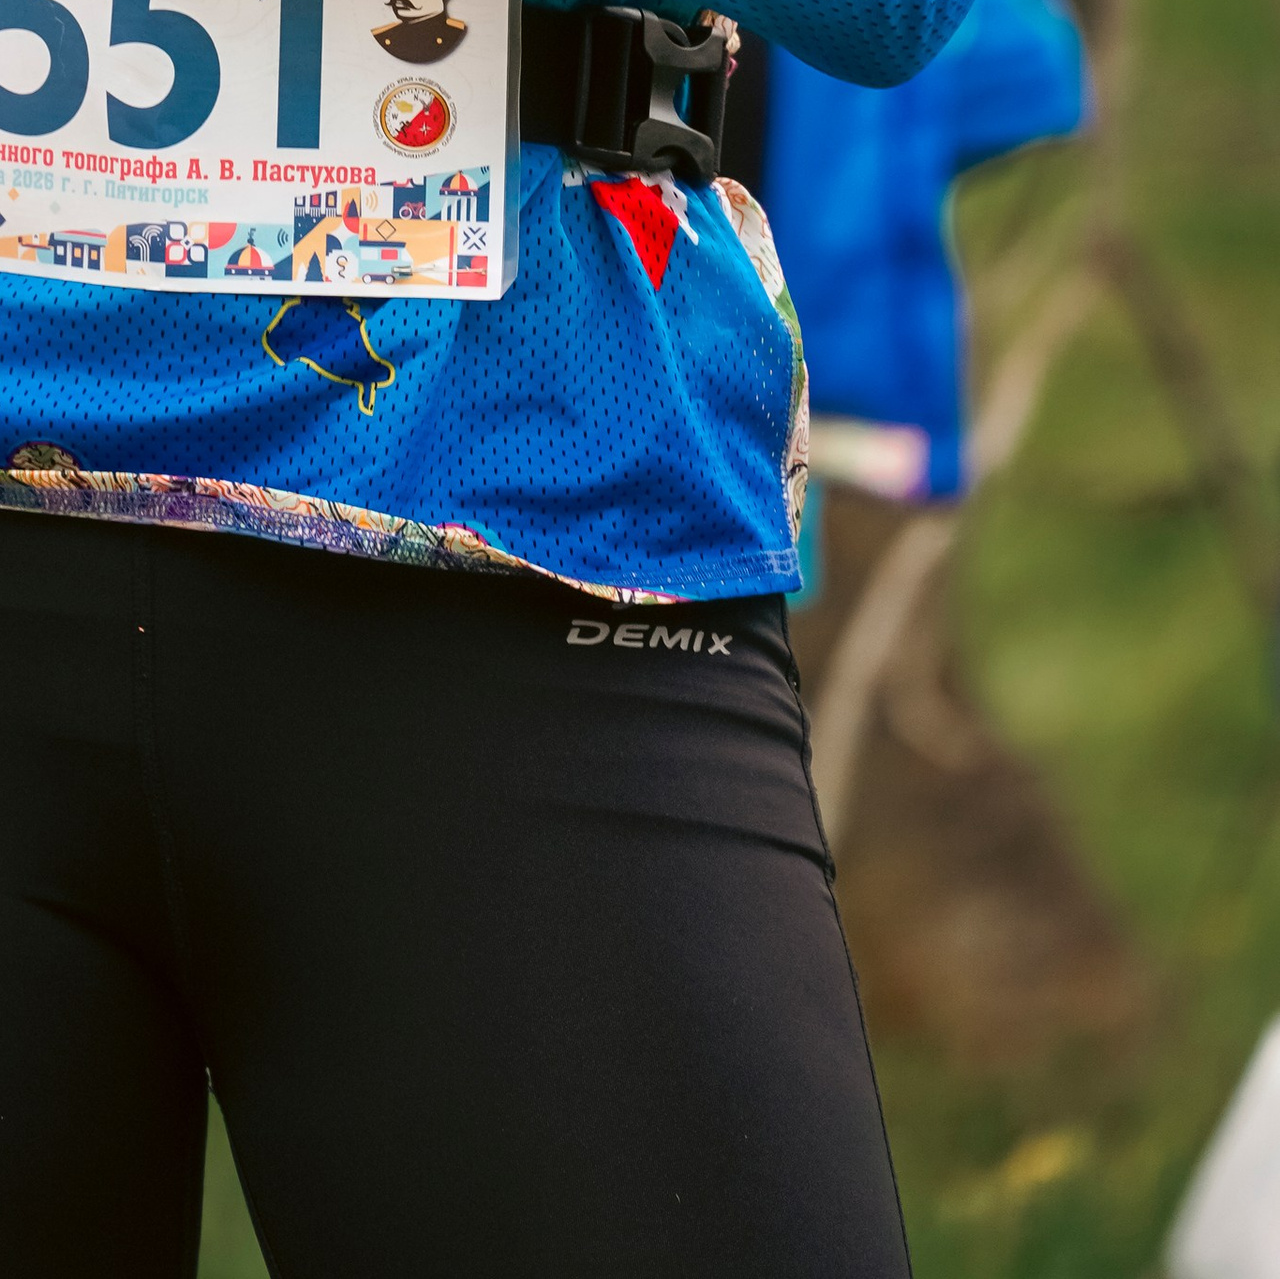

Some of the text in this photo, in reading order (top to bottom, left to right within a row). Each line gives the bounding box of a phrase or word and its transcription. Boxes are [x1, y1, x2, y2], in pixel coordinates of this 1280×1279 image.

[62, 149, 178, 184] топографа
[186, 158, 209, 180] А.
[219, 159, 242, 181] В.
[252, 159, 377, 189] Пастухова
[61, 176, 76, 194] г.
[83, 180, 98, 197] г.
[105, 179, 209, 208] Пятигорск
[566, 619, 733, 656] DEMIX
